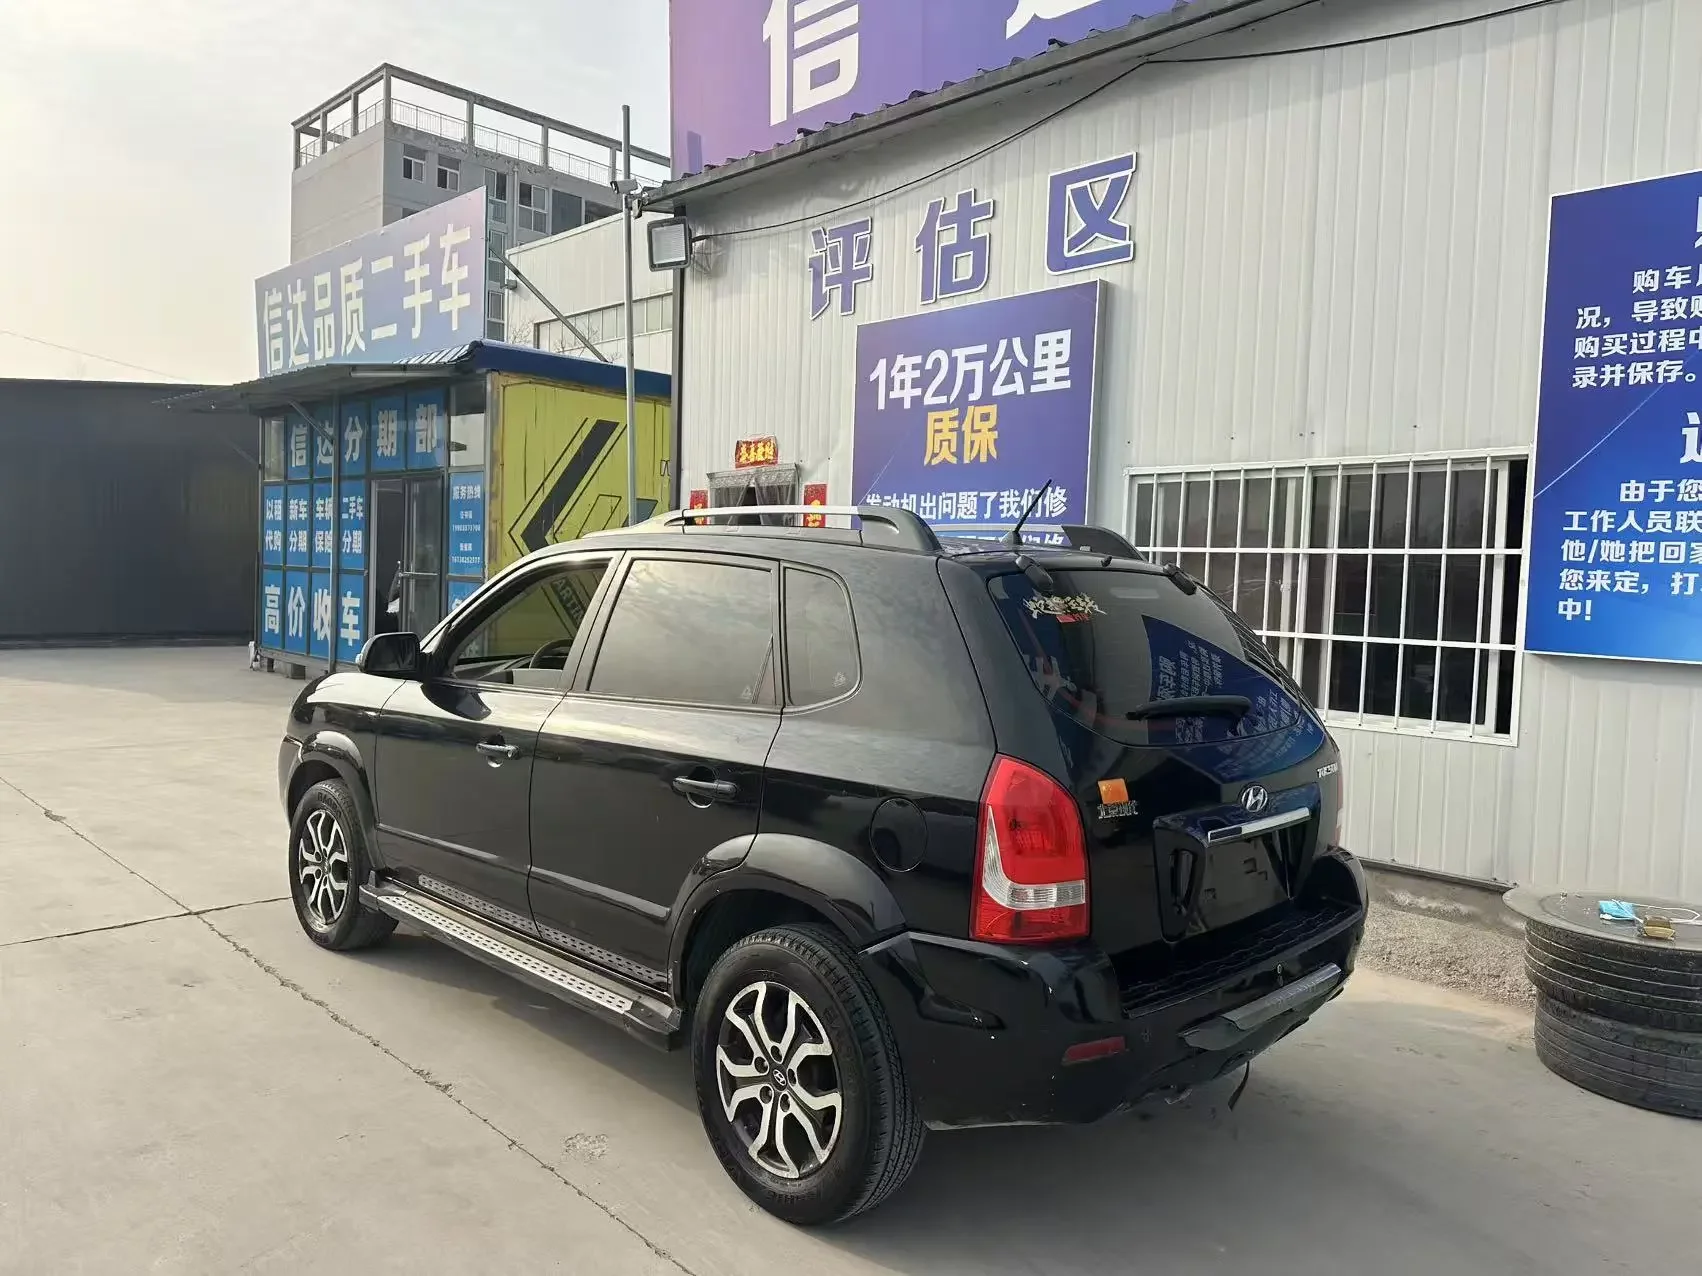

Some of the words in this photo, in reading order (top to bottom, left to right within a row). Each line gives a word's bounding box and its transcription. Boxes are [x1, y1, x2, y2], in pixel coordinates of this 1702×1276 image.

[807, 152, 1137, 320] 评估区
[1633, 264, 1702, 294] 购车
[264, 224, 471, 374] 信达品质二手车
[869, 329, 1071, 410] 1年2万公里
[1572, 359, 1696, 388] 录并保存。
[291, 404, 437, 467] 信达分期部
[924, 404, 998, 466] 质保
[1620, 478, 1702, 502] 由于您
[289, 498, 308, 520] 新车
[342, 496, 363, 520] 二手车
[1563, 510, 1702, 533] 工作人员联
[265, 529, 282, 551] 代购
[289, 529, 307, 552] 分期
[342, 529, 362, 553] 分期
[1559, 569, 1702, 595] 您来定，打
[265, 584, 360, 646] 高价收车
